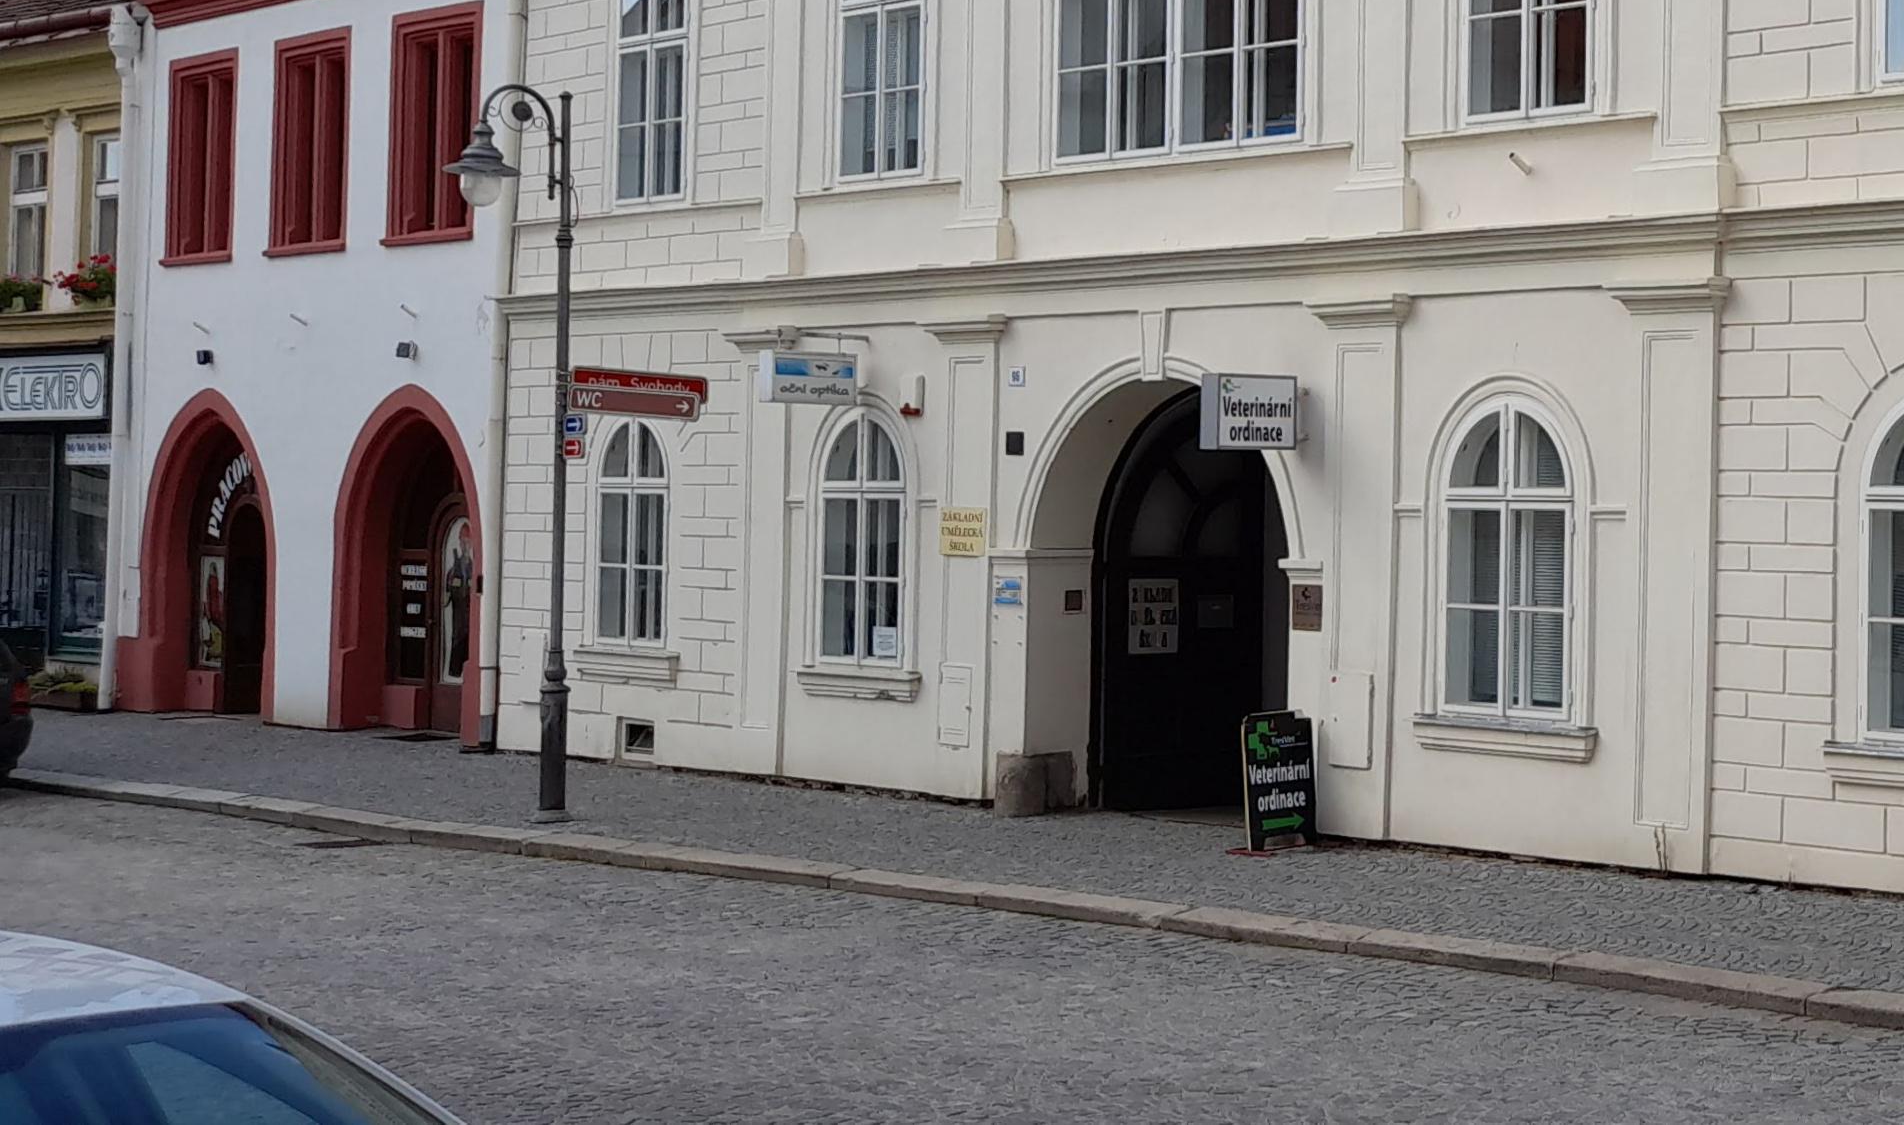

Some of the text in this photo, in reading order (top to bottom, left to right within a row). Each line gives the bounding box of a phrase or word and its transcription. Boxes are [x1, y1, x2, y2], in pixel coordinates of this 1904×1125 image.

[4, 362, 102, 411] ELEKTRO
[810, 383, 849, 398] optika
[577, 391, 602, 407] WC
[1223, 395, 1292, 418] Veterinární
[1229, 420, 1283, 442] ordinace
[942, 511, 983, 523] ZÁKLADNÍ
[941, 524, 983, 537] UMĚLECKÁ
[949, 539, 974, 552] ŠKOLA
[1248, 758, 1311, 785] Veterinární
[1257, 788, 1306, 812] ordinace
